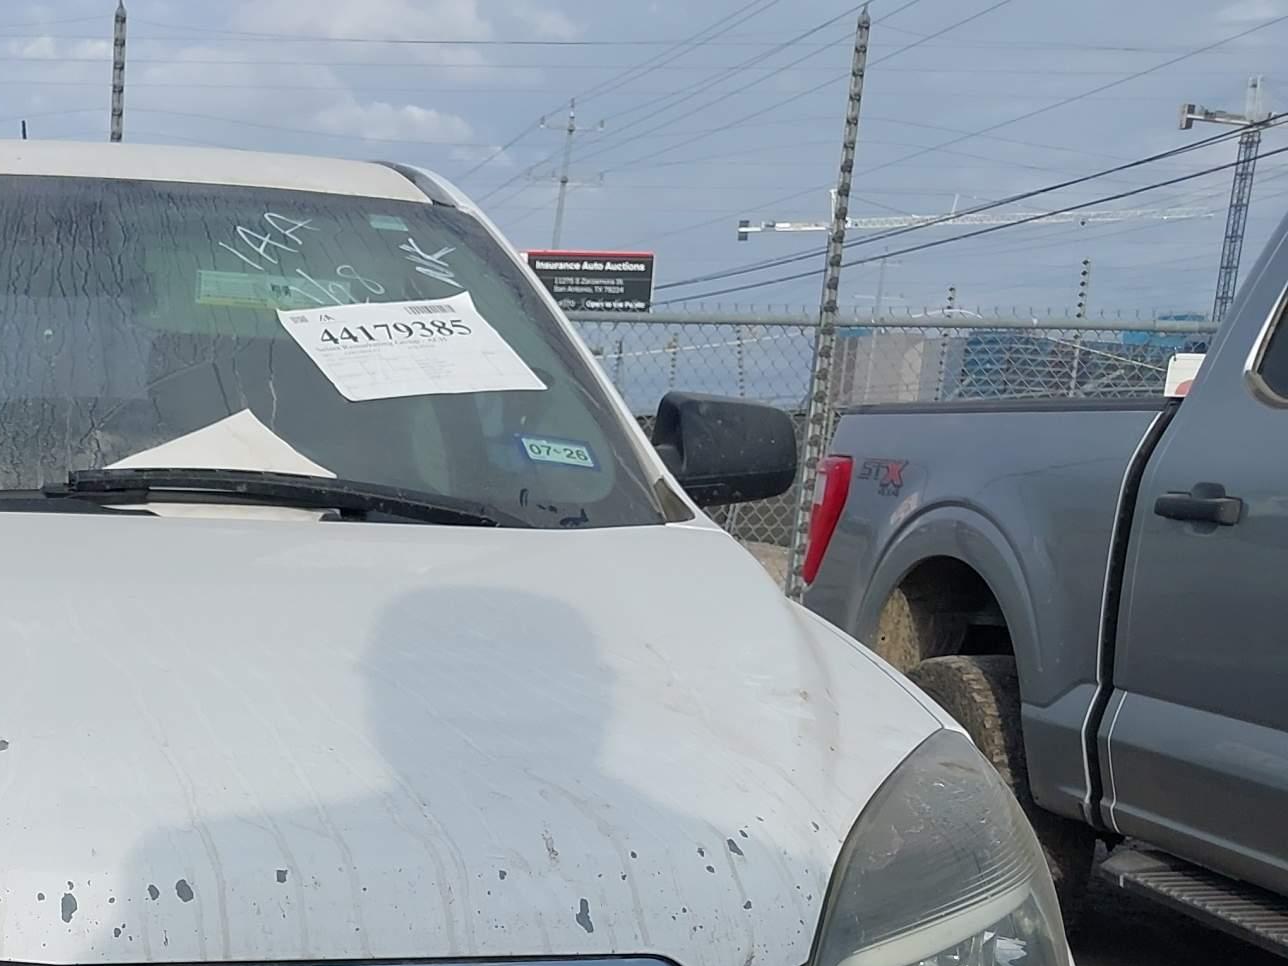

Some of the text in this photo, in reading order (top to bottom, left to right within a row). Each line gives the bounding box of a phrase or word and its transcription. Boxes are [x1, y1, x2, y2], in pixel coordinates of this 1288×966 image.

[535, 261, 646, 272] Insurance Auto Auctions
[319, 319, 473, 346] 44179385
[857, 458, 911, 488] STX
